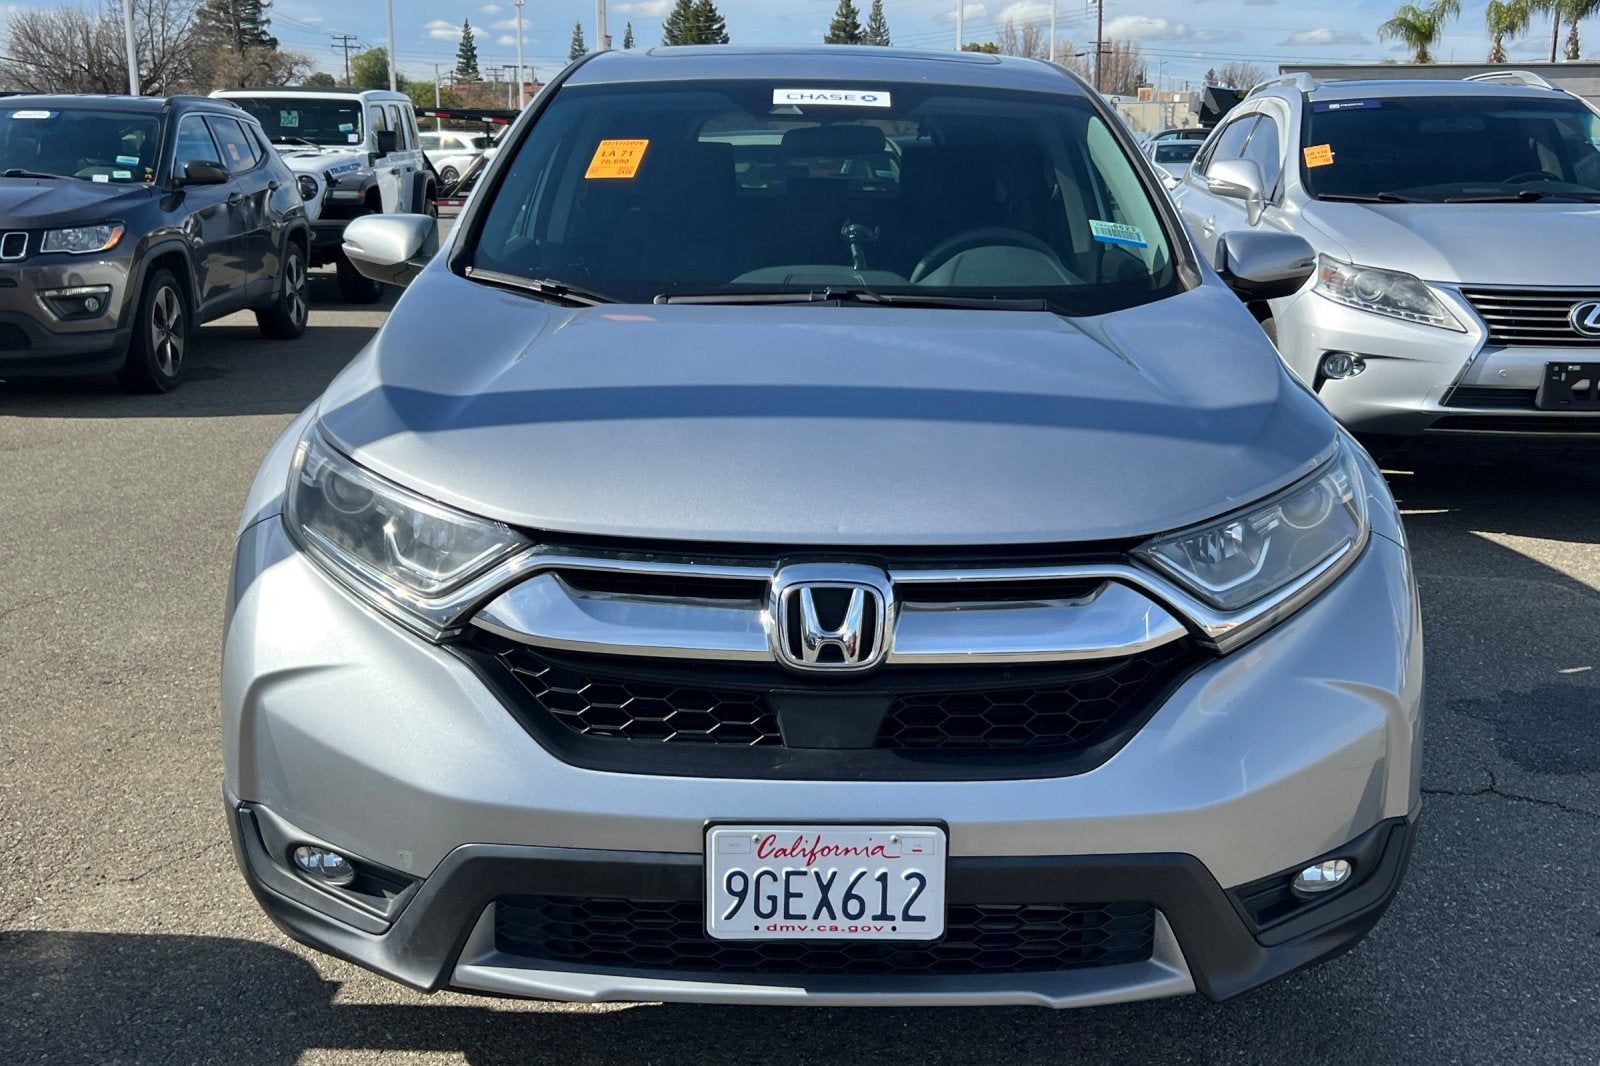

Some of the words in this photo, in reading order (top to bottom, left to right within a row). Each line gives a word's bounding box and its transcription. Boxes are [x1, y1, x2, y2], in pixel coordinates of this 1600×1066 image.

[786, 93, 857, 101] CHASE
[757, 834, 902, 866] California
[724, 870, 927, 922] 9GEX612
[766, 923, 885, 933] dmv.ca.gov
